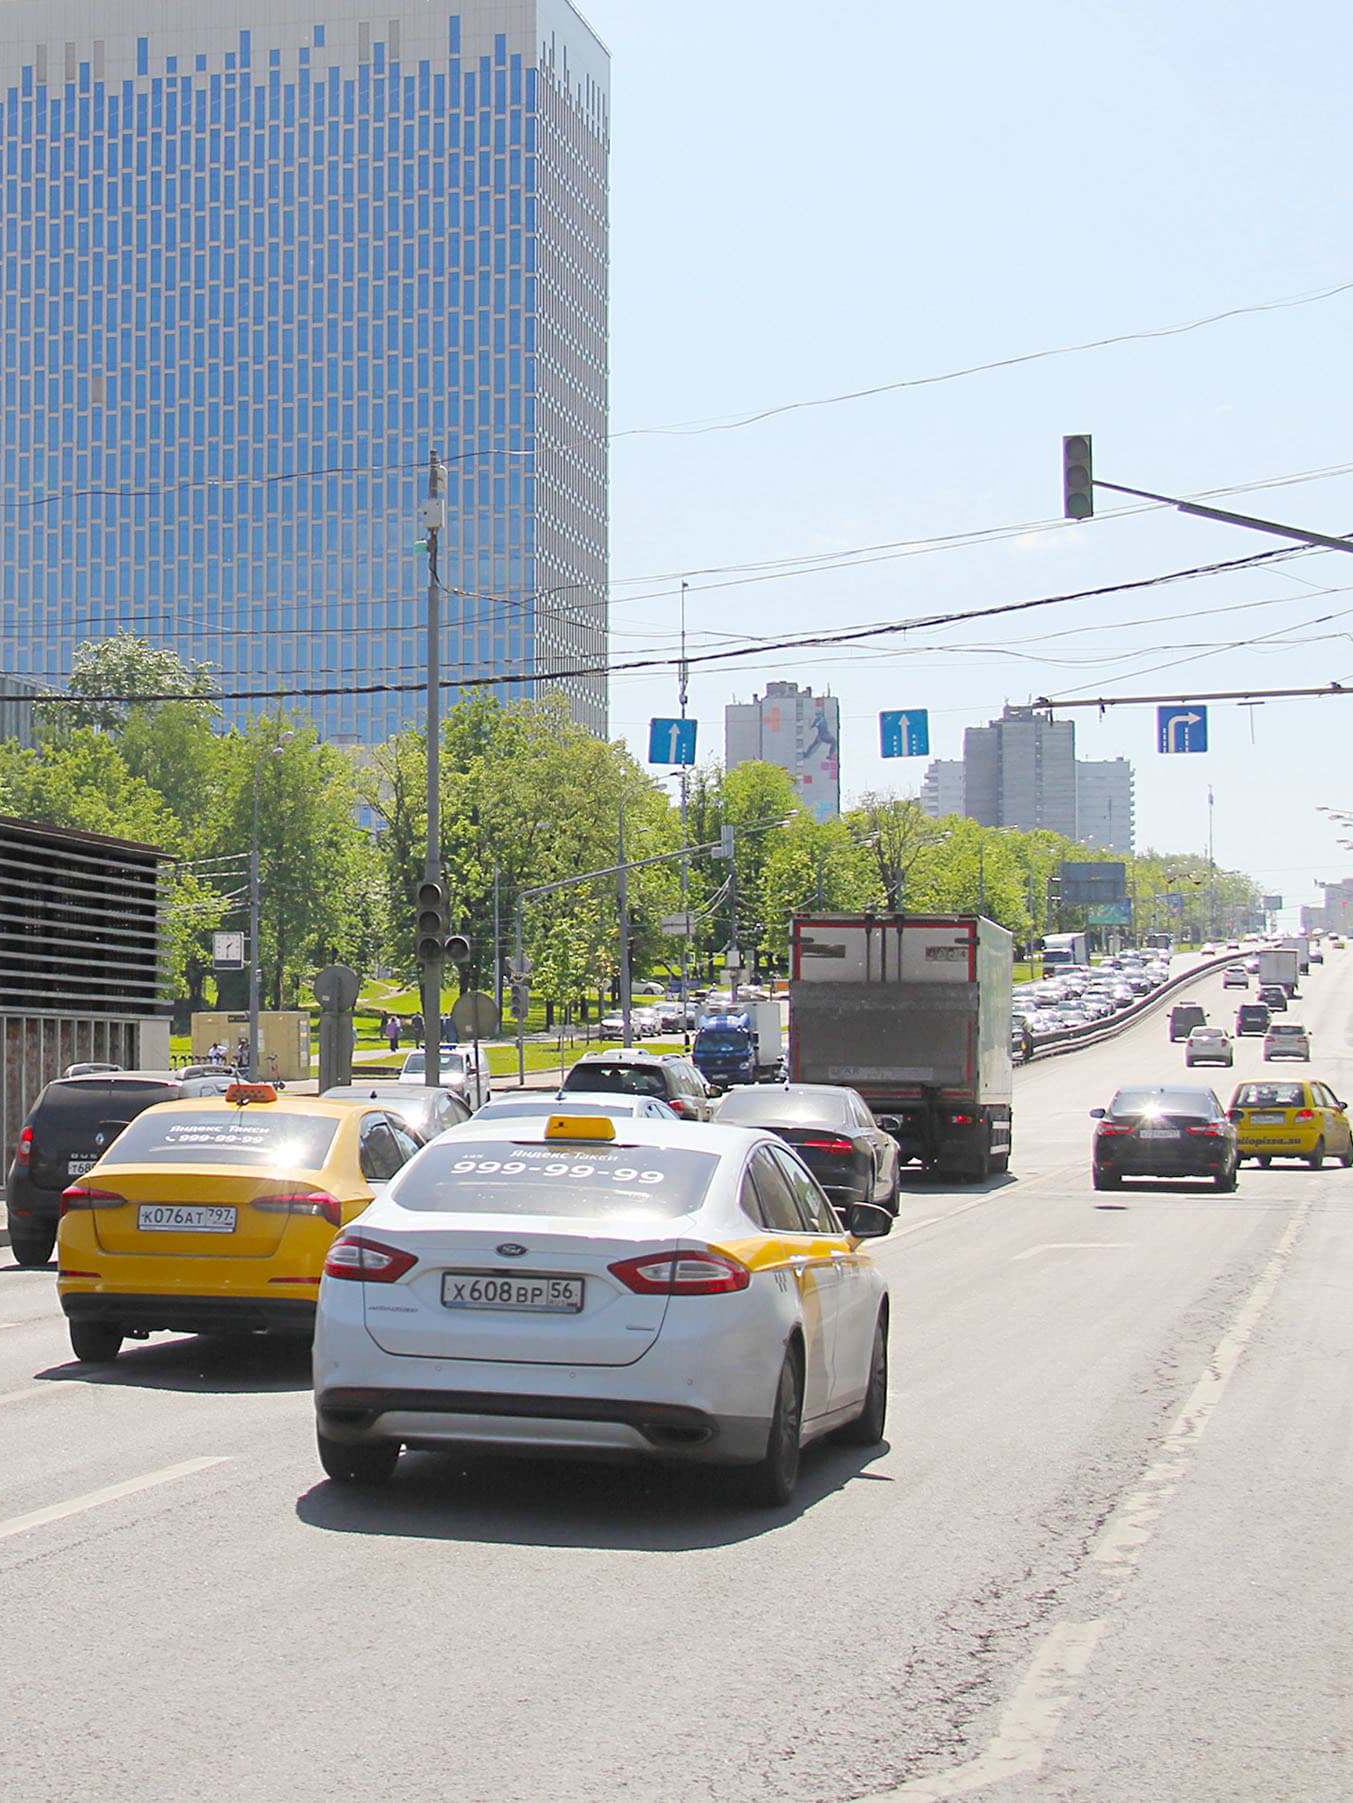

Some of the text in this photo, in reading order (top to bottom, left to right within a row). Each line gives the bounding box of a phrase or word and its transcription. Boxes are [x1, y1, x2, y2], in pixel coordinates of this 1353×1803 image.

[178, 1134, 265, 1144] 999-99-99
[509, 1149, 570, 1160] Яндекс
[450, 1161, 665, 1185] 999-99-99
[550, 1281, 573, 1299] 56
